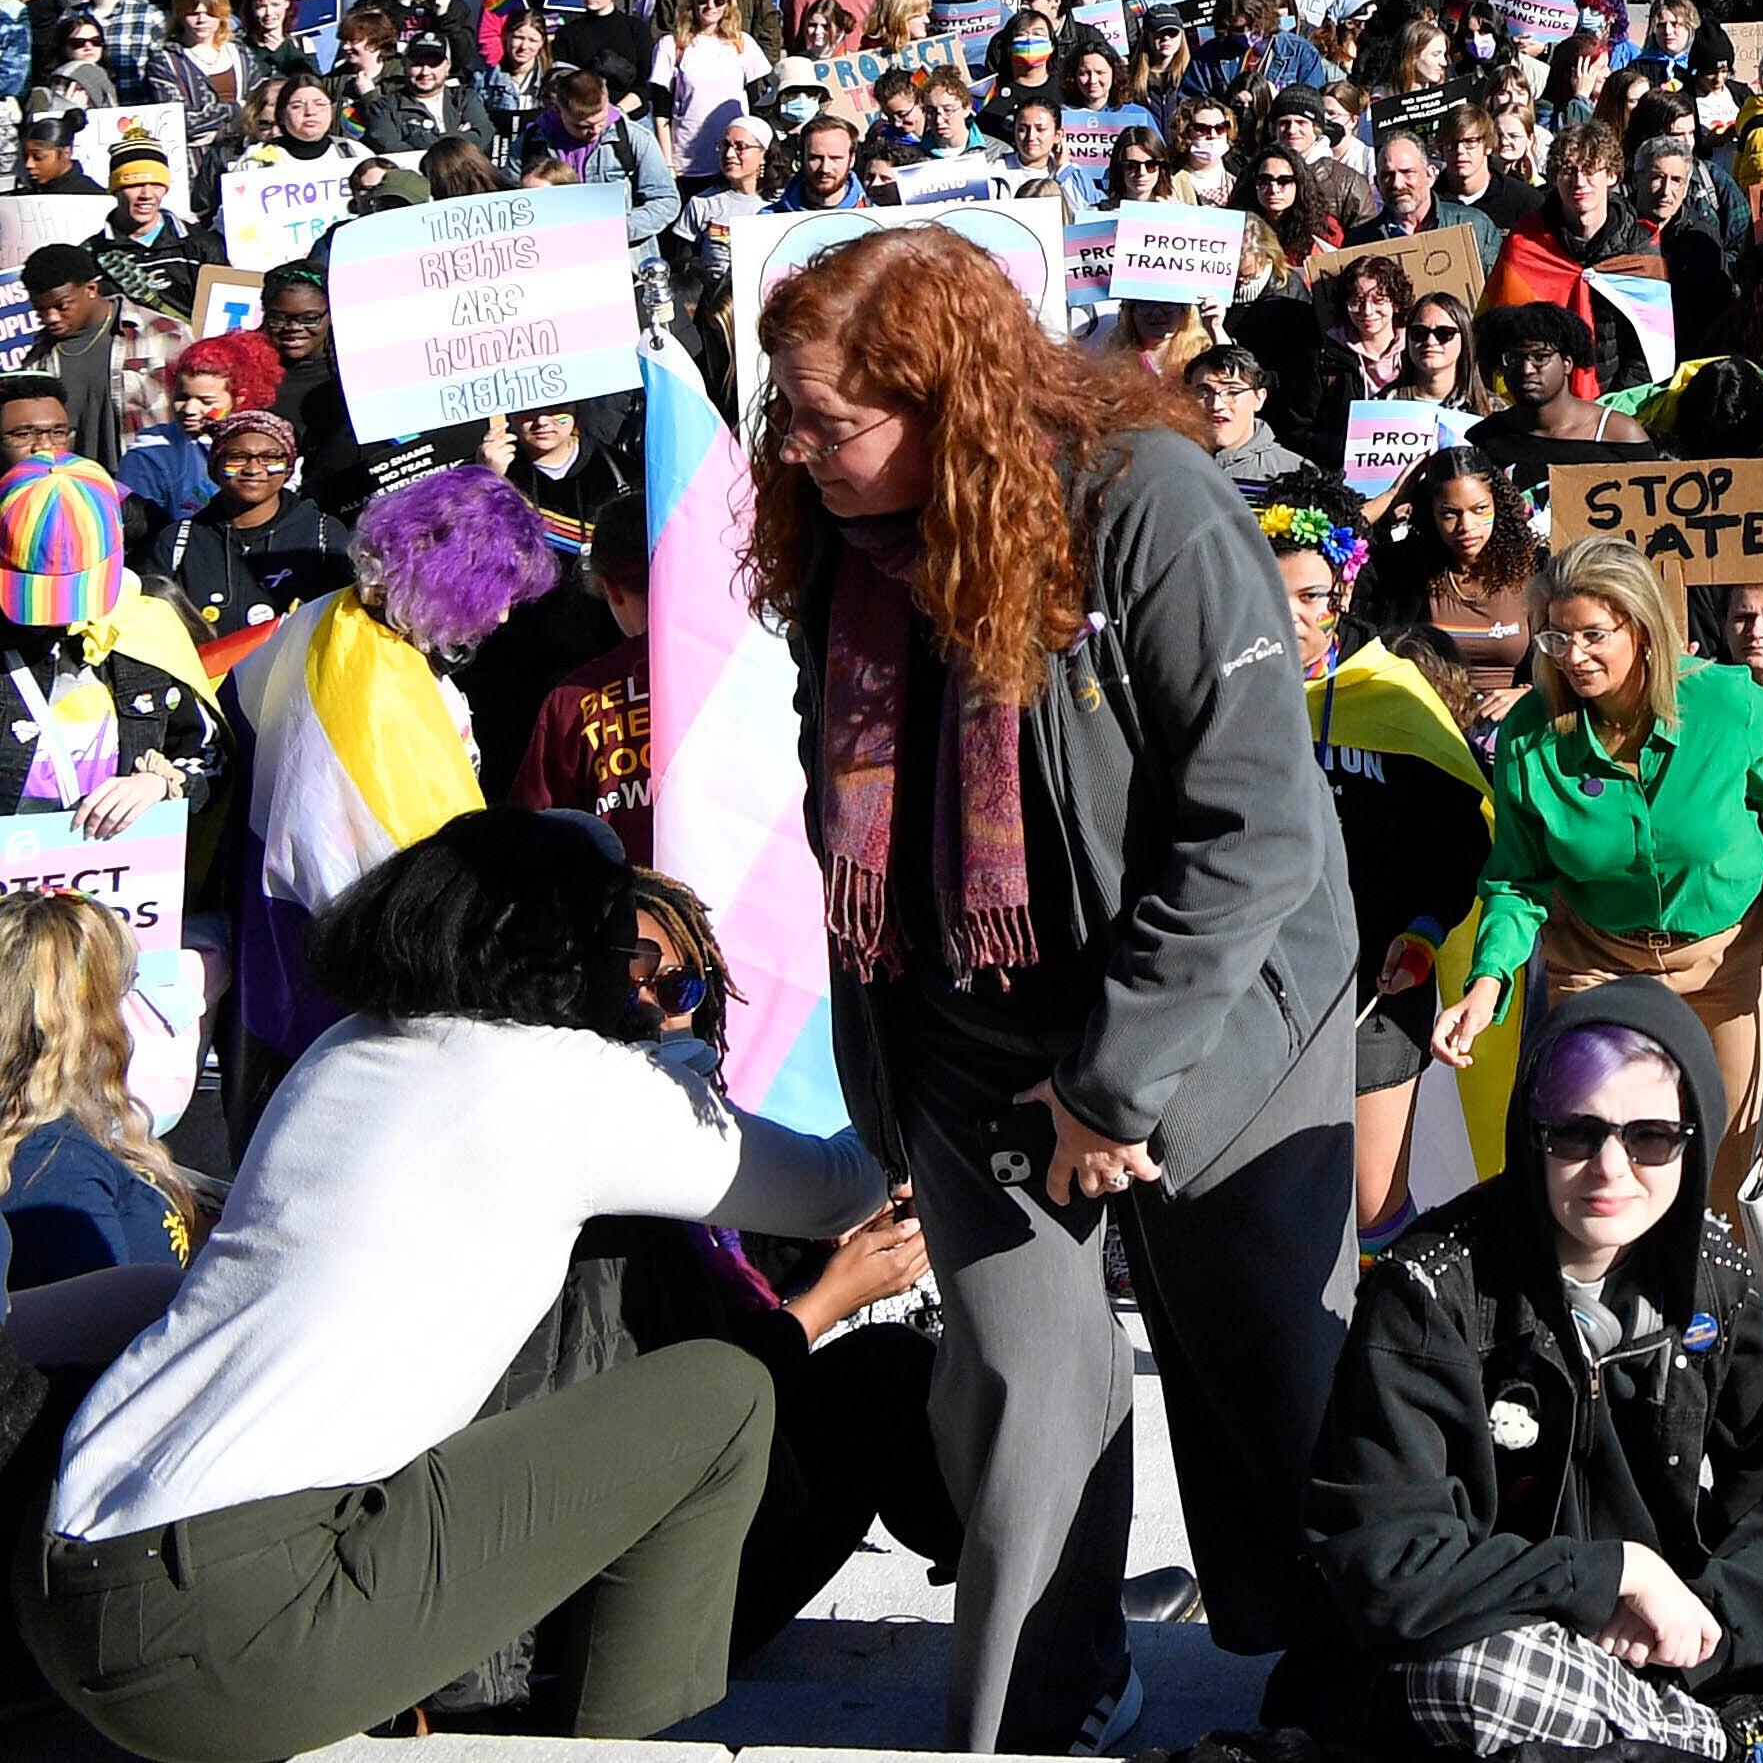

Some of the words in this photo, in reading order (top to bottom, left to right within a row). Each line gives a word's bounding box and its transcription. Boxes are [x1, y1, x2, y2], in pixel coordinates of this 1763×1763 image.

[1494, 3, 1535, 28] TRANS
[1538, 14, 1570, 31] KIDS
[1143, 233, 1228, 255] PROTECT
[1125, 252, 1194, 272] TRANS
[1199, 255, 1233, 277] KIDS
[368, 460, 391, 476] NO
[390, 442, 435, 466] SHAME
[378, 470, 399, 486] NO
[400, 455, 434, 478] FEAR
[1584, 466, 1734, 530] STOP
